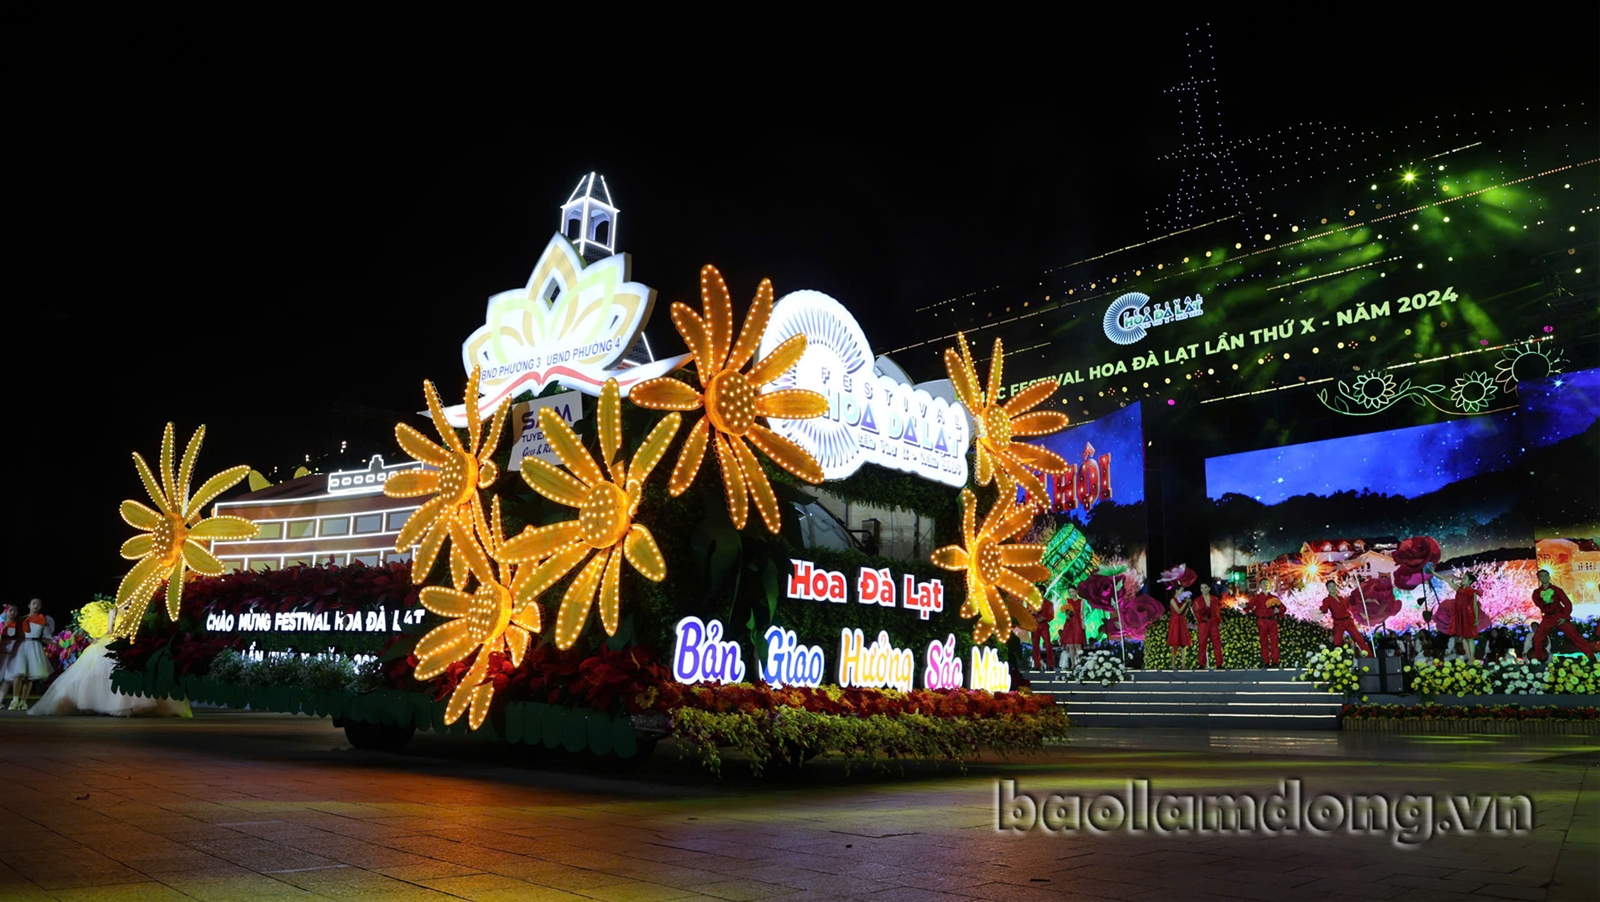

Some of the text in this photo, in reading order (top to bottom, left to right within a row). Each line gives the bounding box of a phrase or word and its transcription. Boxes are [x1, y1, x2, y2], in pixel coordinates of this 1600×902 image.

[536, 357, 541, 368] 3
[546, 351, 571, 366] UBND
[614, 337, 621, 348] 4
[1089, 360, 1128, 380] HOA
[1131, 350, 1160, 371] ĐÀ
[1164, 343, 1200, 365] LẠT
[1204, 331, 1245, 355] LẦN
[1249, 318, 1295, 344] THỨ
[1300, 317, 1316, 335] X
[1336, 301, 1391, 327] NĂM
[1397, 286, 1459, 314] 2024
[522, 404, 572, 431] SM
[821, 367, 962, 431] FESTIVAL
[1052, 442, 1112, 513] HỘI
[206, 609, 234, 632] CHÀO
[238, 608, 272, 632] MỪNG
[274, 611, 331, 632] FESTIVAL
[366, 605, 386, 632] ĐÀ
[788, 560, 944, 620] Hoa Đà Lạt
[674, 616, 746, 685] Bản
[764, 626, 824, 689] Giao
[926, 634, 963, 690] Sắc
[971, 646, 1011, 694] Màu
